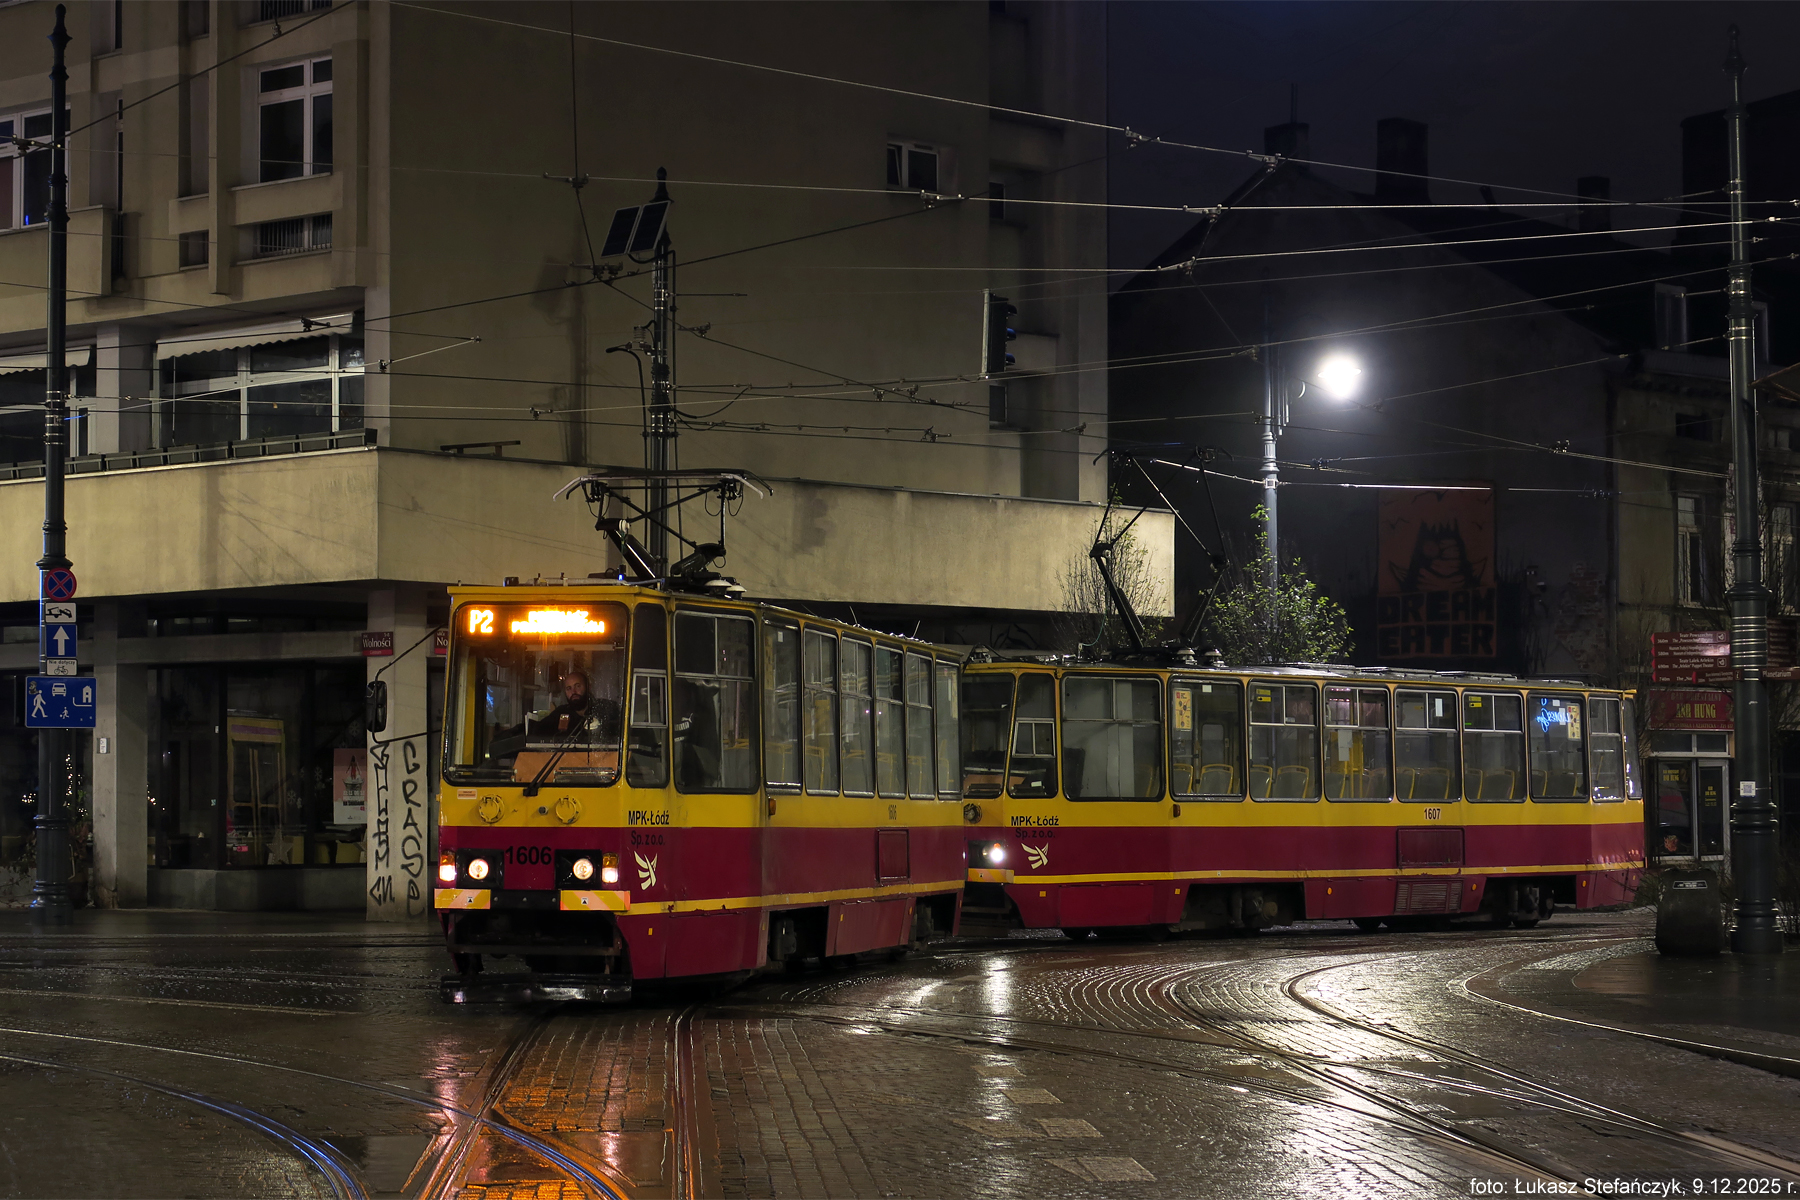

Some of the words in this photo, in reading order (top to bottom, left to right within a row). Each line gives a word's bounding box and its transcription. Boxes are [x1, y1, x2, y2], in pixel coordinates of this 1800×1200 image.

[1378, 588, 1496, 624] DREAM
[469, 609, 493, 633] P2
[362, 638, 391, 648] Wolności
[1378, 624, 1496, 657] EATER
[1762, 670, 1791, 678] Planetarium
[628, 810, 670, 825] MPK-Łódź
[1011, 815, 1059, 826] MPK-Łódź
[1424, 808, 1441, 820] 1607
[505, 846, 552, 865] 1606
